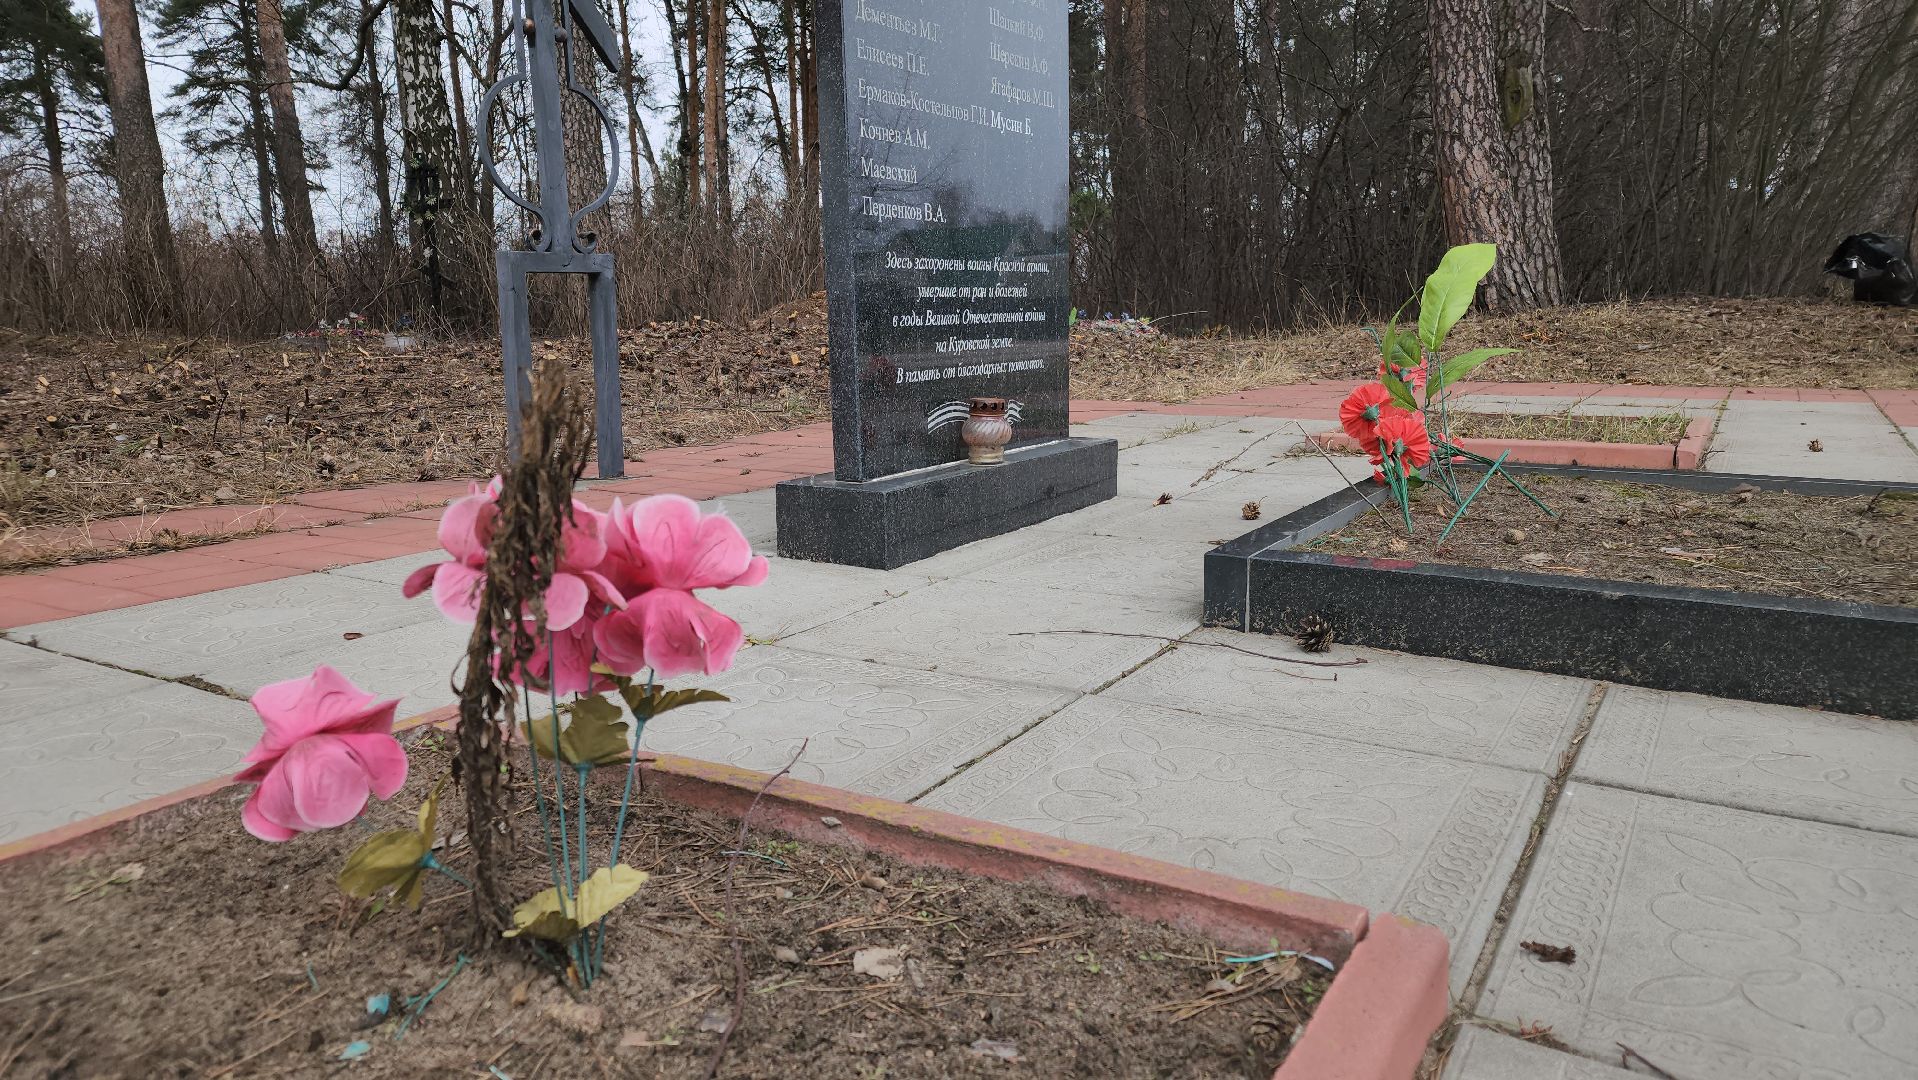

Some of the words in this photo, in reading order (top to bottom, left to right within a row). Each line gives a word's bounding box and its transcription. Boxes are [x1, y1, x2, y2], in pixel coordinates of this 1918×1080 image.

[855, 0, 917, 36] Дементьев
[856, 38, 904, 70] Елисеев
[906, 52, 930, 76] П.Е.
[858, 78, 969, 121] Ермаков-Костельцов
[990, 77, 1031, 105] Ягафаров
[859, 117, 901, 144] Кочнев
[904, 127, 930, 150] А.М.
[991, 110, 1022, 134] Мусин
[1025, 118, 1034, 136] Б.
[861, 156, 918, 184] Маевский
[862, 196, 922, 222] Перденков
[924, 203, 947, 223] В.А.
[885, 251, 912, 269] Здесь
[914, 256, 965, 274] захоронены
[967, 260, 992, 272] воины
[993, 256, 1025, 276] Красной
[917, 285, 957, 302] умершие
[958, 287, 971, 298] от
[972, 287, 987, 302] ран
[988, 287, 995, 298] и
[995, 283, 1028, 298] болезней
[892, 317, 898, 327] в
[899, 310, 924, 327] годы
[925, 309, 961, 326] Великой
[962, 308, 1024, 325] Отечественной
[1024, 308, 1046, 322] войны
[935, 341, 947, 353] на
[948, 335, 990, 355] Куровской
[896, 368, 904, 384] В
[905, 369, 940, 383] память
[942, 367, 956, 379] от
[957, 361, 1007, 378] благодарных
